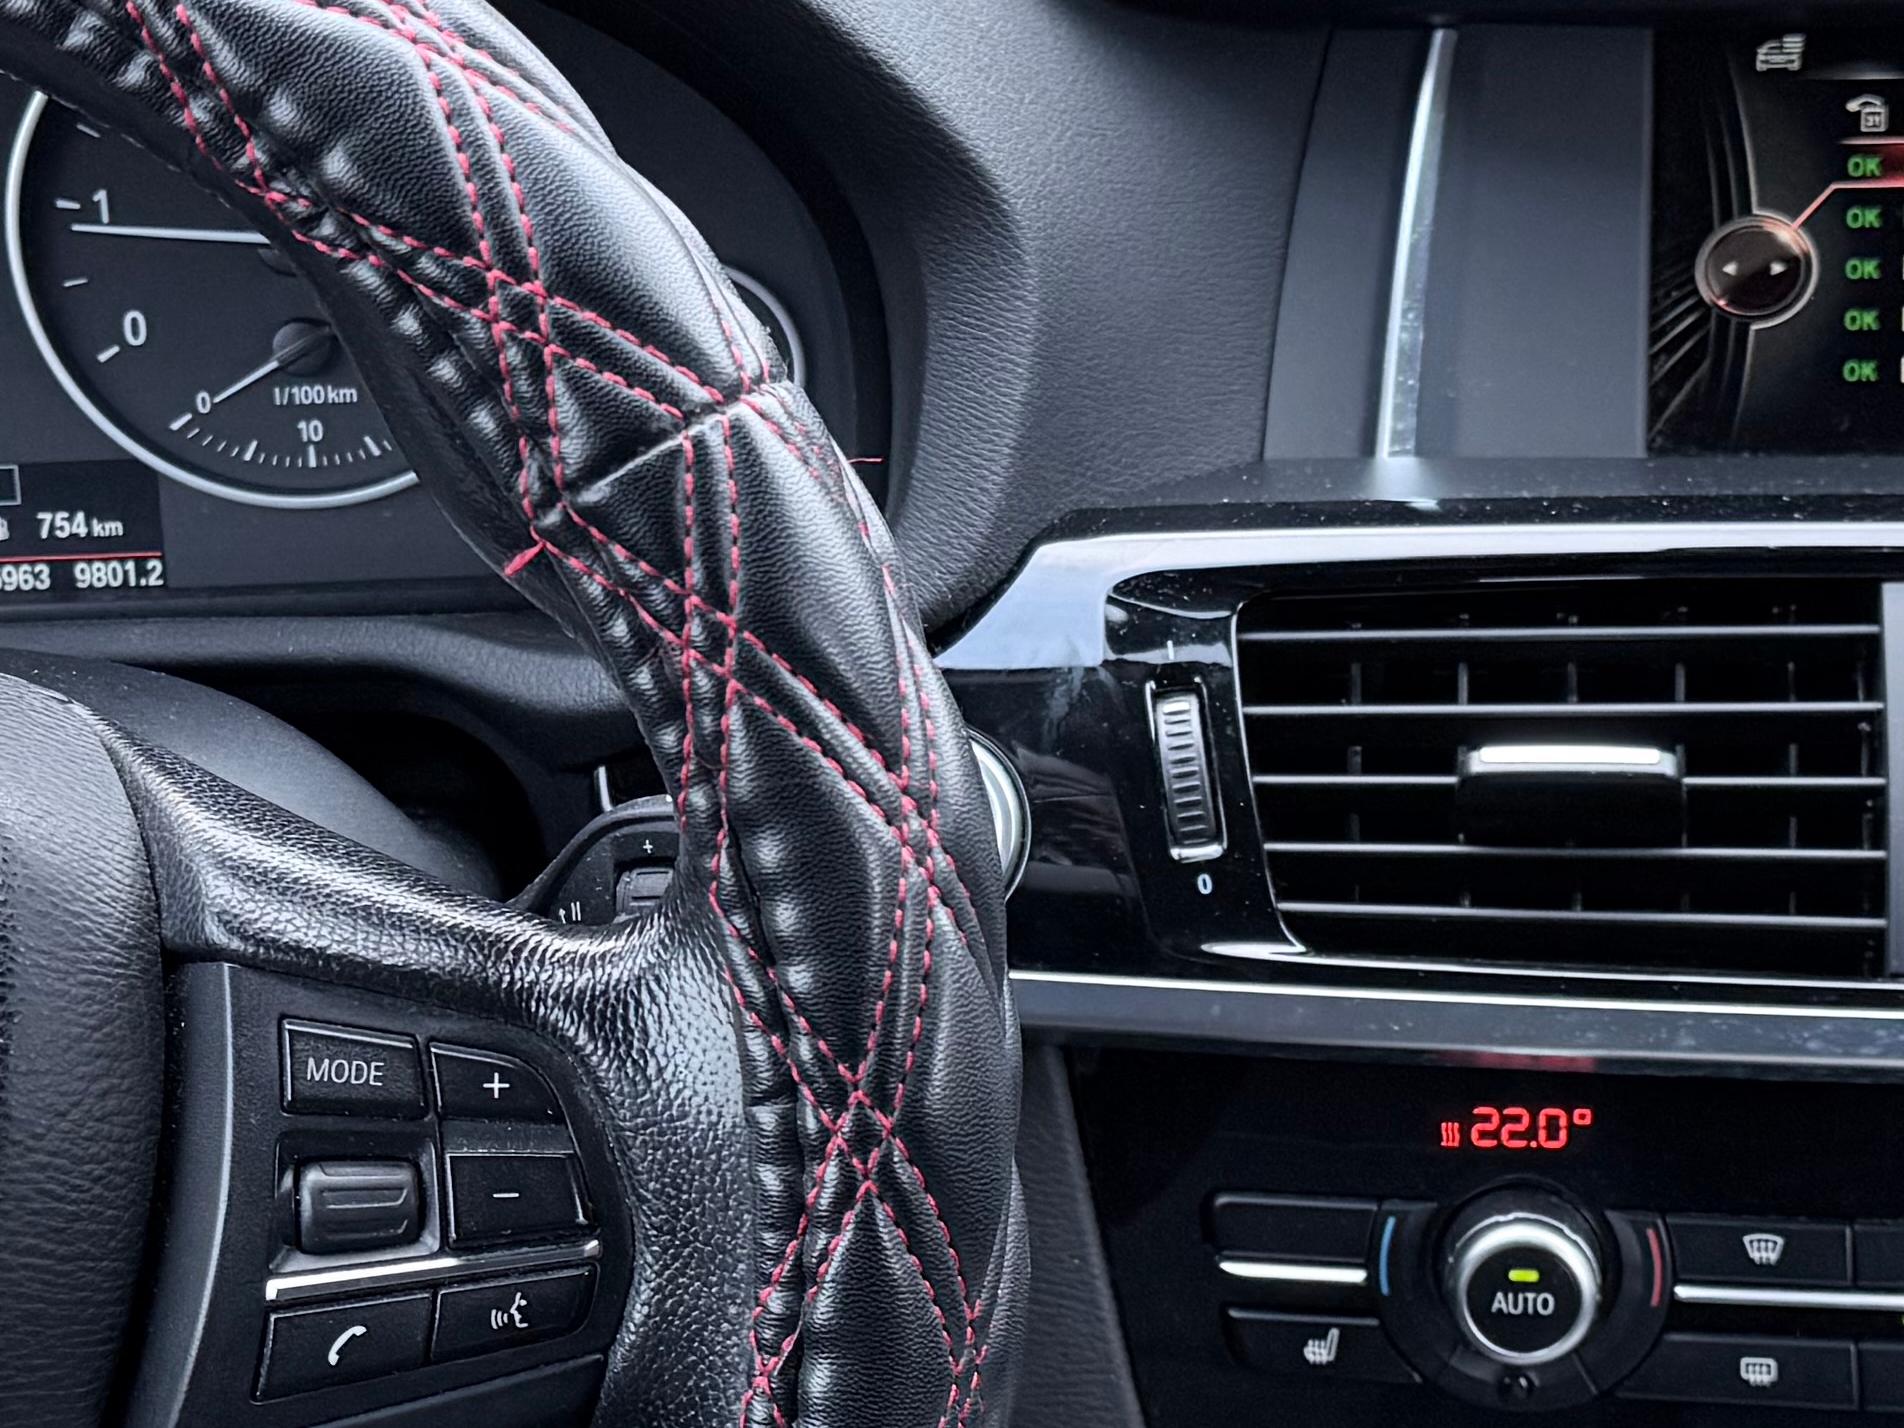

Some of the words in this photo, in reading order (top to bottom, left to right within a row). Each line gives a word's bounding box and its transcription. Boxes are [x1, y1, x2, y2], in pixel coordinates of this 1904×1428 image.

[1848, 154, 1882, 177] OK
[92, 190, 109, 224] 1
[1846, 206, 1882, 229] OK
[1845, 257, 1882, 280] OK
[123, 310, 147, 347] 0
[1844, 308, 1881, 330] OK
[1842, 359, 1879, 382] OK
[196, 391, 212, 414] 0
[297, 419, 324, 443] 10
[37, 510, 88, 539] 754
[92, 518, 124, 537] km
[74, 558, 164, 589] 9801.2
[306, 1057, 385, 1087] MODE
[1491, 1291, 1555, 1317] AUTO
